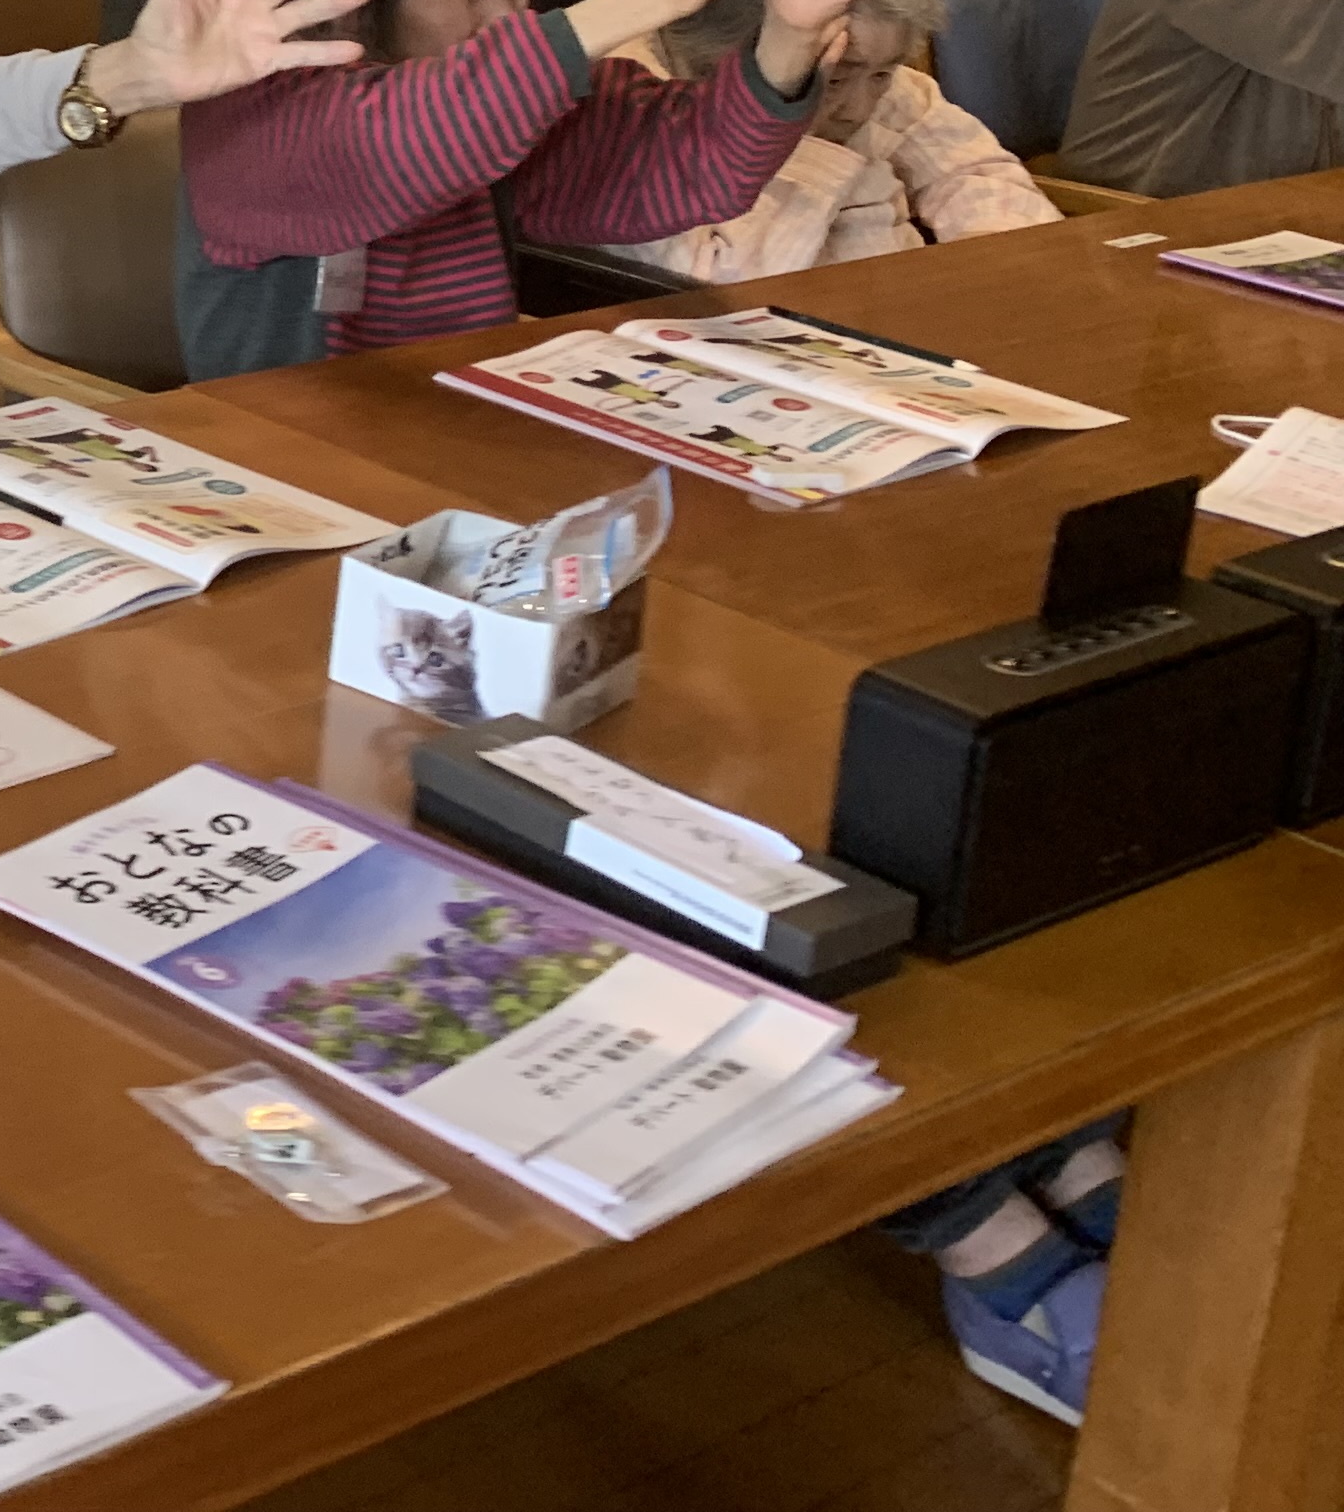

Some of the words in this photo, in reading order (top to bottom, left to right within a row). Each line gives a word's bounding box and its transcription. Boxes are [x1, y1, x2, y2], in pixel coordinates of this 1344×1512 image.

[48, 811, 251, 905] おとなの
[124, 844, 299, 929] 教科書
